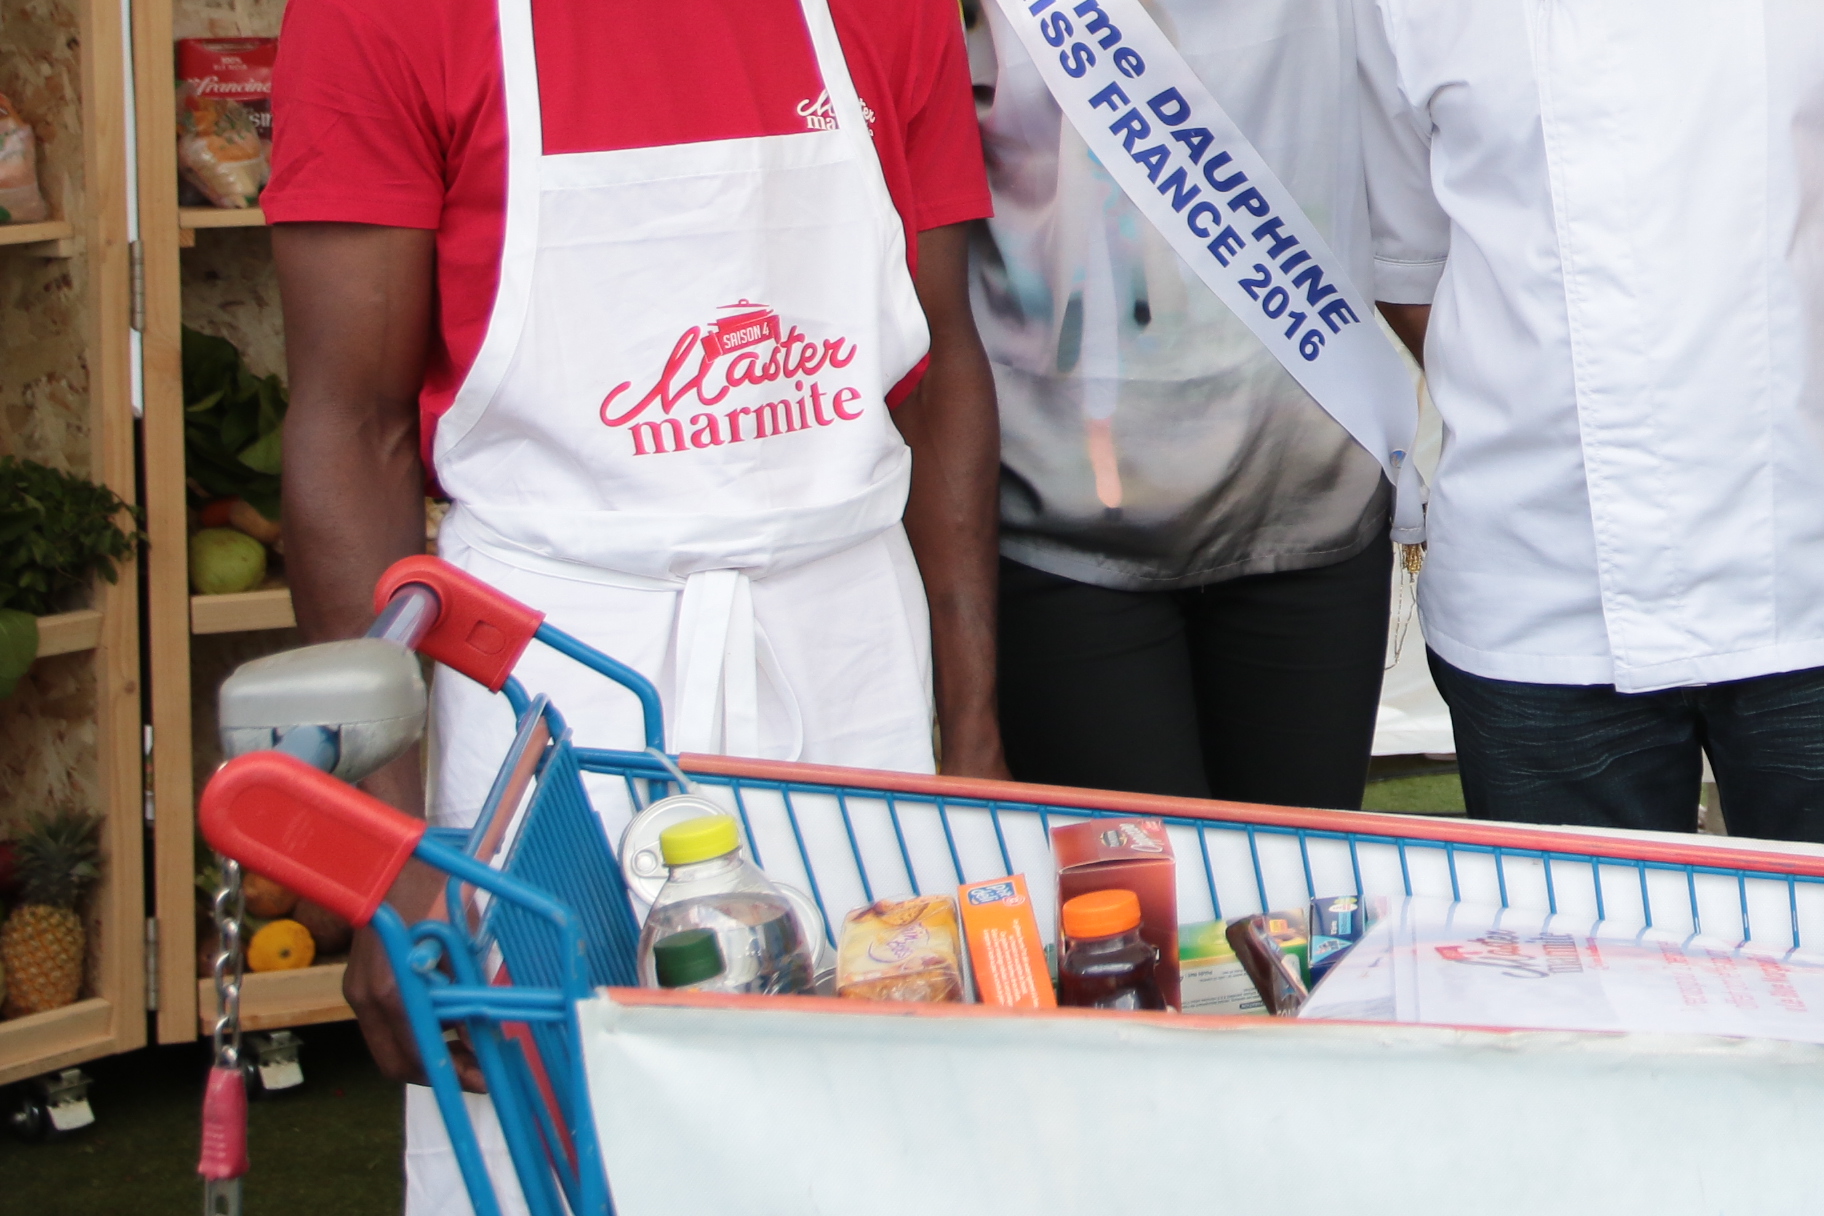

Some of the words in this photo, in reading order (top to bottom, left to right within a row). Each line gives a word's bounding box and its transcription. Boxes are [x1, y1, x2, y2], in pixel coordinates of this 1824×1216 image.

[1088, 81, 1247, 267] FRANCE
[1239, 263, 1327, 362] 2016
[1146, 86, 1361, 335] DAUPHINE
[599, 325, 857, 427] Master
[723, 325, 762, 350] SAISON
[762, 322, 770, 336] 4
[627, 379, 865, 456] marmite
